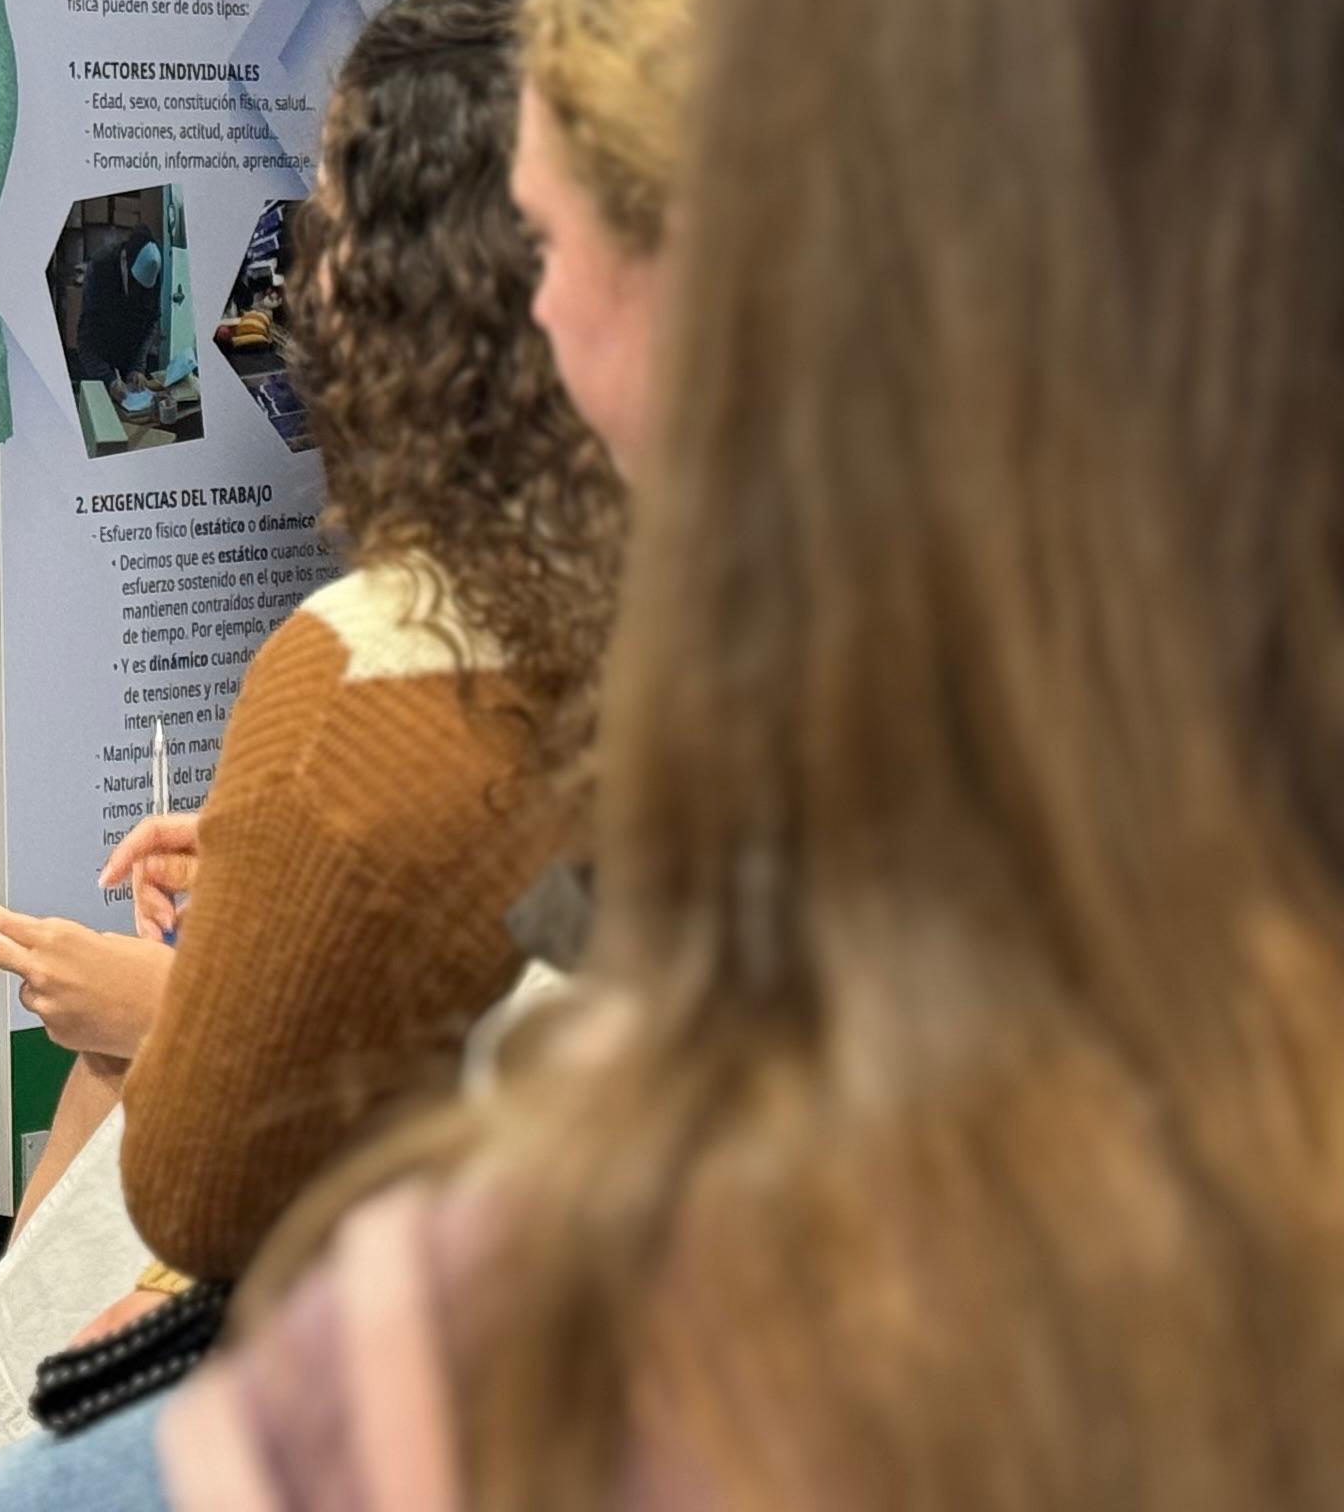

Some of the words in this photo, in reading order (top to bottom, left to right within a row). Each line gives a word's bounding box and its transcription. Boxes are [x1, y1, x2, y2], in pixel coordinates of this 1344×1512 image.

[152, 2, 171, 14] ser
[174, 0, 189, 15] de
[192, 0, 214, 15] dos
[217, 1, 249, 19] tipos:
[68, 61, 80, 79] 1.
[84, 62, 156, 80] FACTORES
[159, 63, 260, 82] INDIVIDUALES
[92, 93, 127, 111] Edad,
[129, 97, 161, 111] sexo,
[163, 93, 236, 111] constitución
[239, 93, 273, 112] física,
[93, 123, 176, 141] Motivaciones,
[179, 123, 224, 142] actitud,
[93, 152, 161, 171] Formación,
[164, 152, 240, 170] información,
[75, 496, 88, 514] 2.
[92, 491, 177, 513] EXIGENCIAS
[181, 489, 207, 507] DEL
[211, 485, 273, 506] TRABAJO
[99, 523, 152, 543] Esfuerzo
[155, 520, 187, 539] físico
[190, 517, 245, 539] (estático
[248, 520, 256, 533] o
[258, 512, 318, 532] dinámico
[120, 554, 173, 571] Decimos
[176, 554, 198, 571] que
[201, 553, 215, 565] es
[218, 545, 268, 563] estático
[271, 542, 314, 559] cuando
[122, 576, 175, 595] esfuerzo
[178, 572, 236, 592] sostenido
[239, 572, 254, 586] en
[257, 568, 268, 584] el
[271, 569, 293, 587] que
[296, 564, 312, 581] los
[123, 600, 188, 620] mantienen
[191, 594, 254, 614] contraídos
[123, 628, 139, 645] de
[141, 624, 187, 645] tiempo.
[191, 622, 212, 638] Por
[215, 617, 266, 640] ejemplo,
[121, 657, 128, 674] Y
[132, 661, 146, 672] es
[149, 651, 208, 671] dinámico
[124, 687, 140, 704] de
[143, 683, 202, 701] tensiones
[203, 684, 211, 700] y
[197, 709, 212, 722] en
[215, 704, 225, 721] la
[174, 766, 192, 785] del
[103, 801, 143, 819] ritmos
